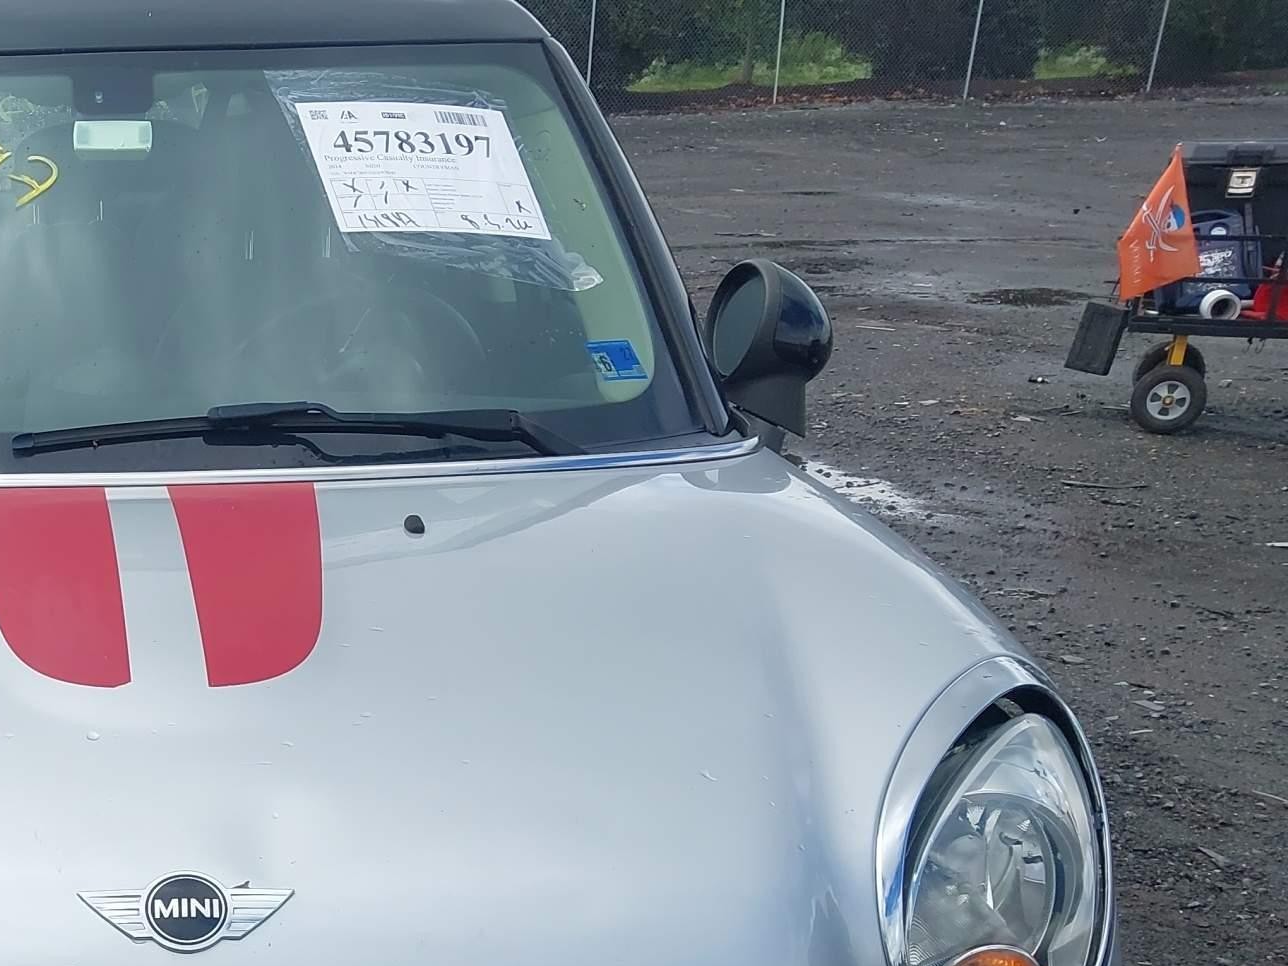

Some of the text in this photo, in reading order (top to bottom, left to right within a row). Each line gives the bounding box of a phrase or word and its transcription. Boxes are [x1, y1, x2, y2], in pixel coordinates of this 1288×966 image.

[333, 130, 490, 158] 45783197
[324, 153, 457, 163] Progressive Casualty Insurance
[154, 898, 220, 919] MINI
